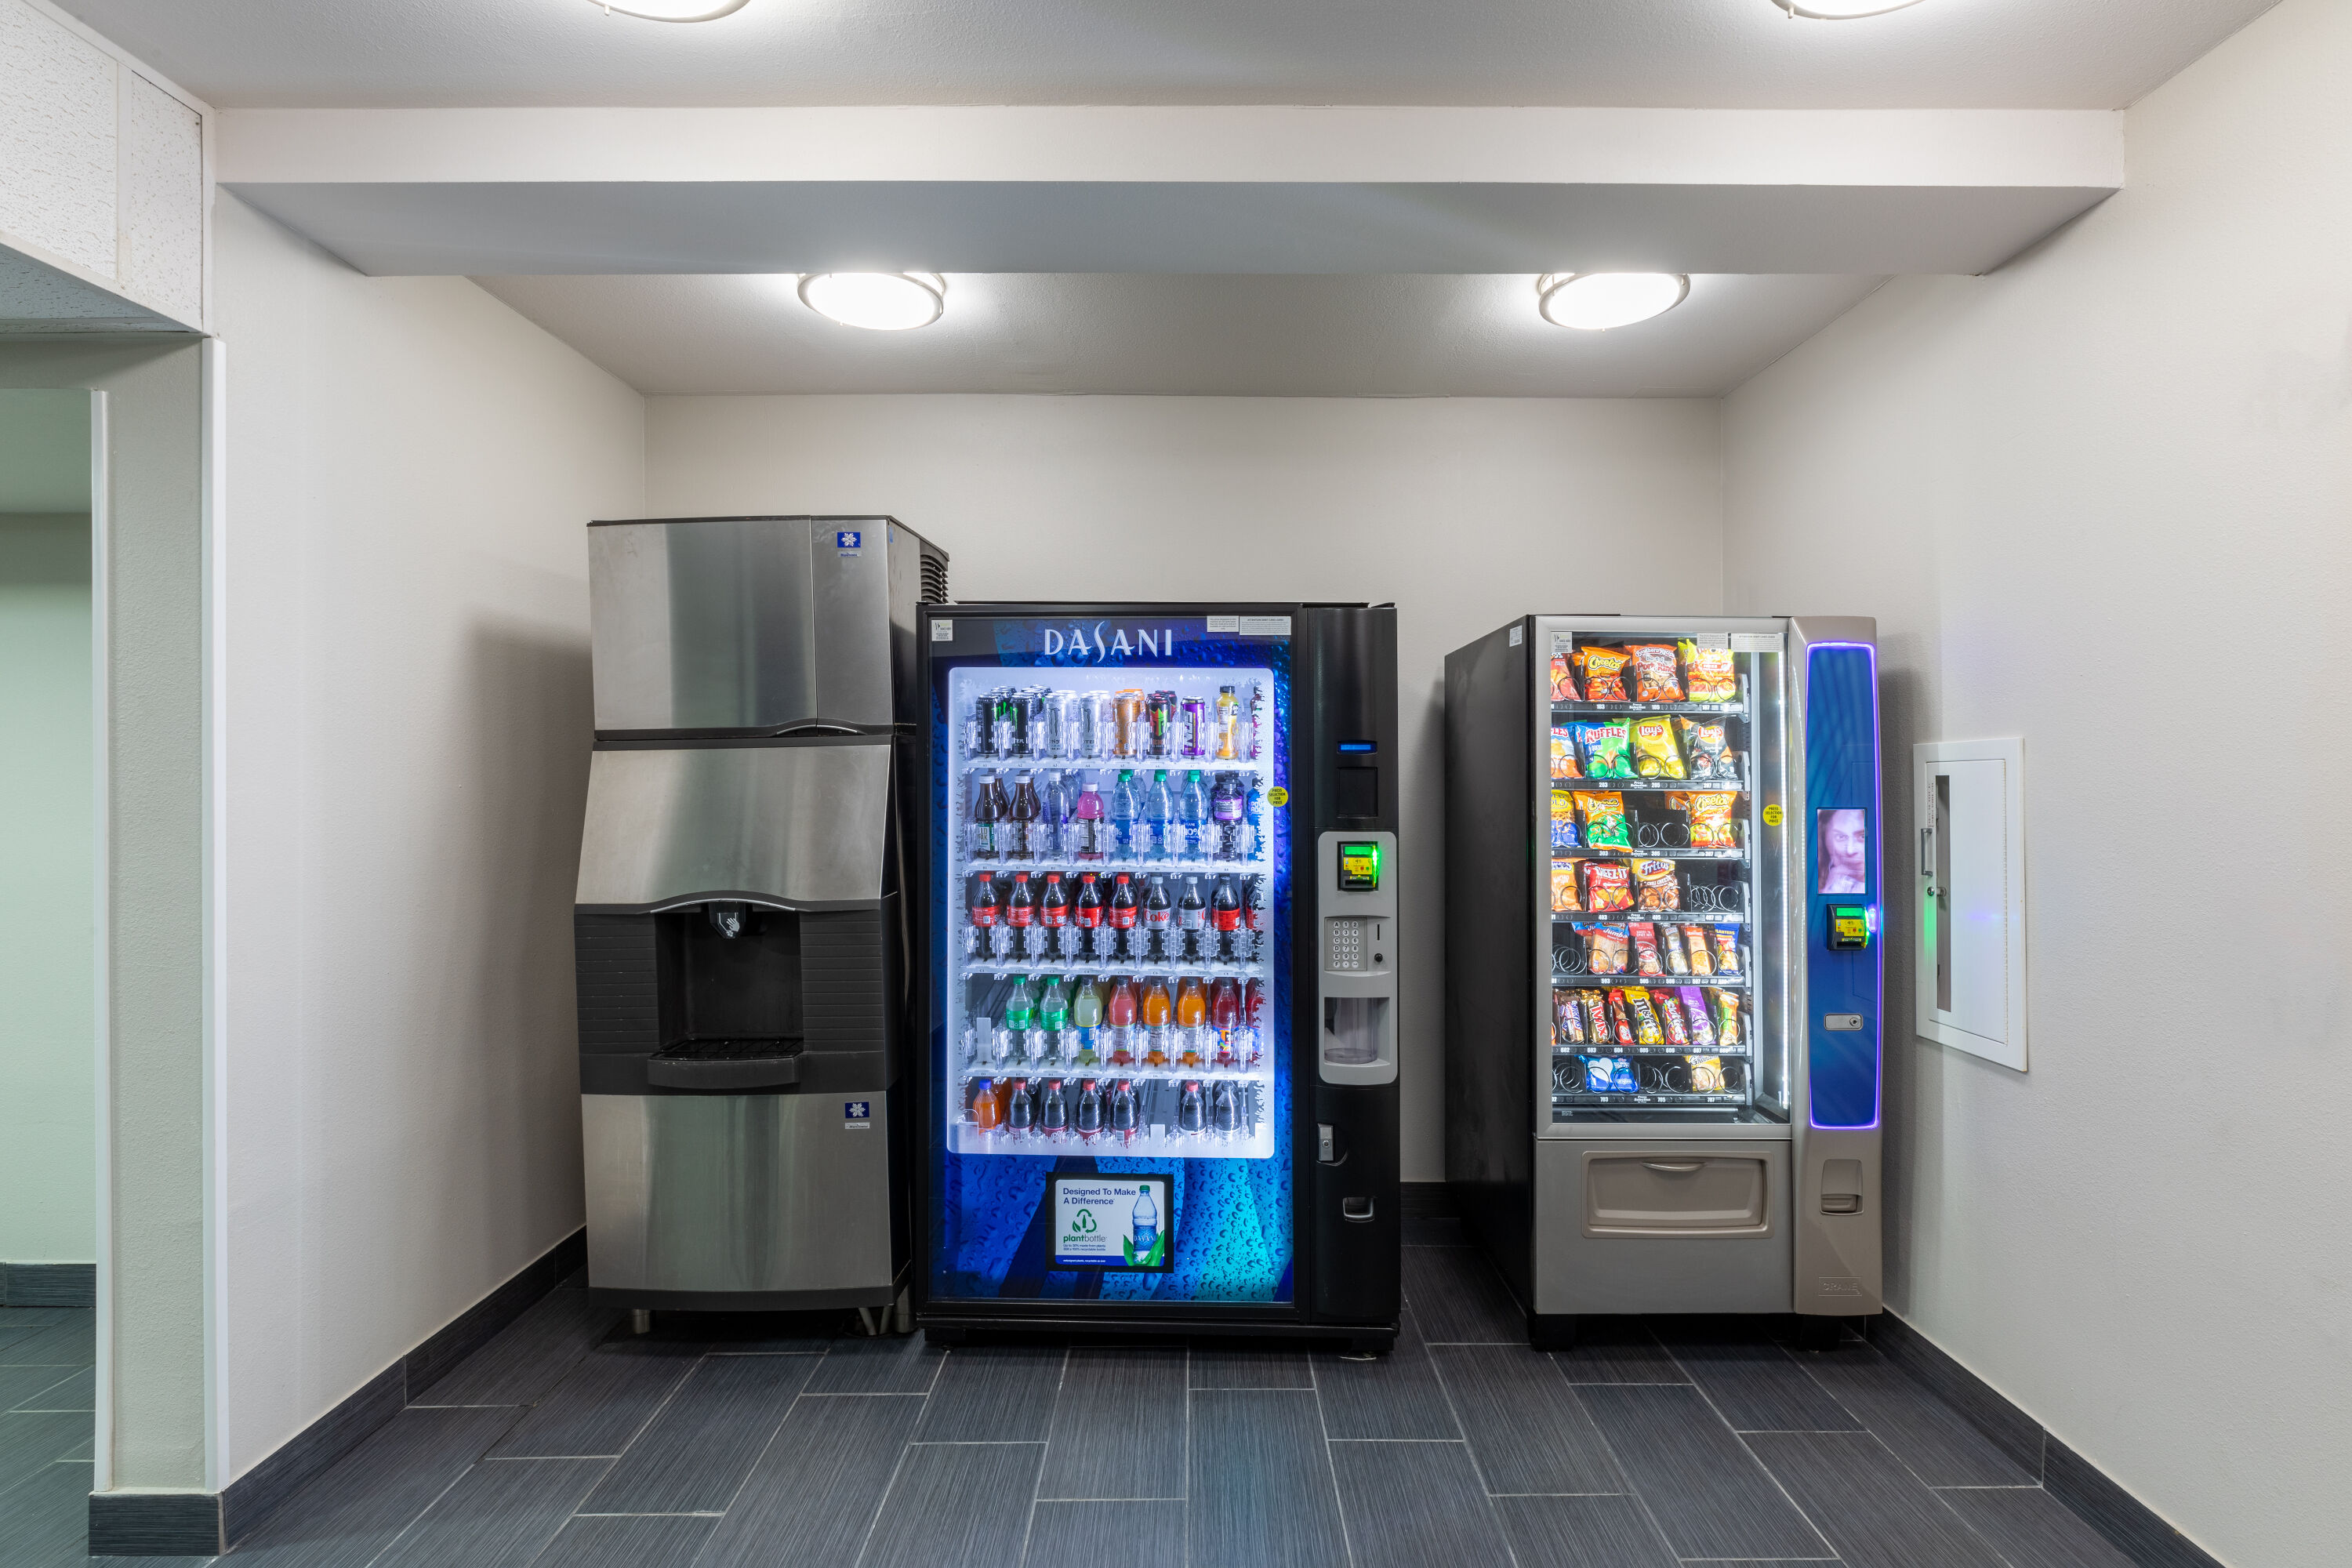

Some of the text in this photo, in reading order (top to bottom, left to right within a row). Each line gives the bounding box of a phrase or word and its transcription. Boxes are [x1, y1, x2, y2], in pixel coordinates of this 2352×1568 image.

[1045, 621, 1171, 662] DASANI
[1588, 656, 1622, 671] Cheetos
[1585, 728, 1627, 744] RUFFLES
[1641, 725, 1663, 737] Lay's
[1640, 860, 1670, 876] Fritos
[1144, 910, 1169, 922] Coke
[1589, 1001, 1608, 1037] TWIX
[1063, 1188, 1100, 1196] Designed
[1063, 1234, 1106, 1243] plantbottle
[1823, 1282, 1857, 1291] CRANE
